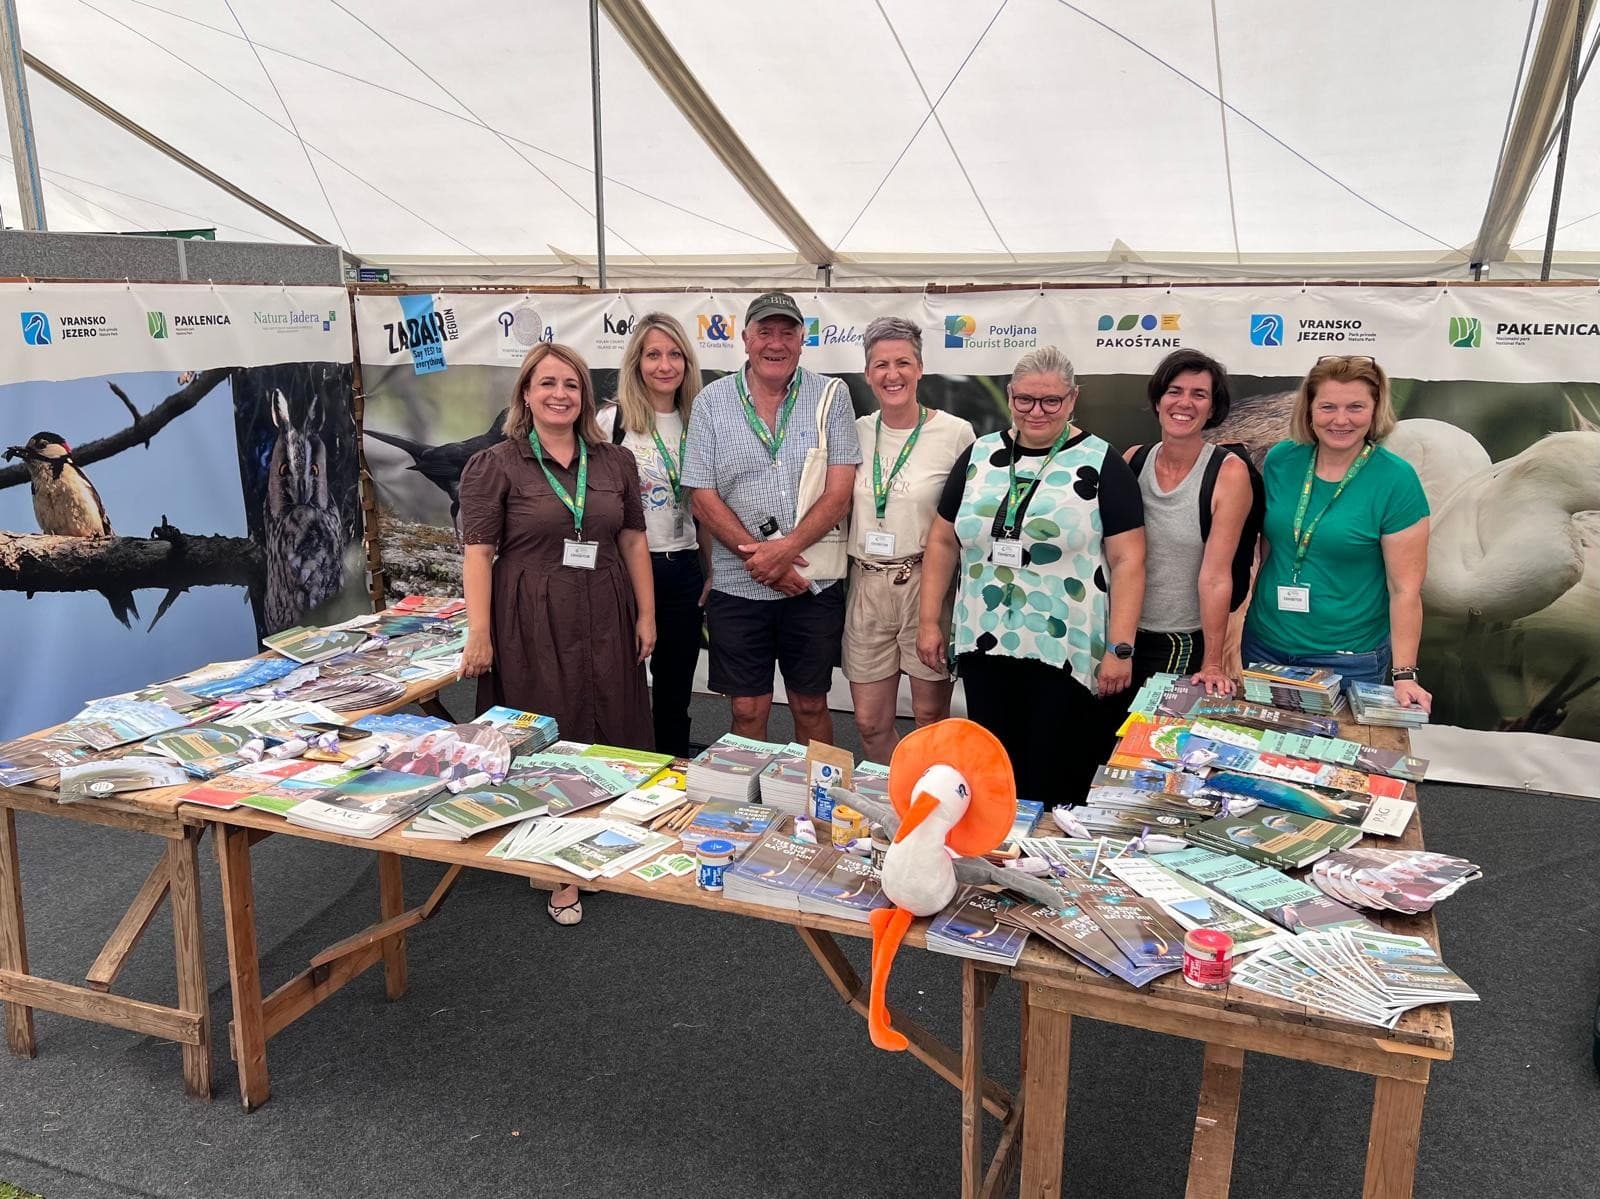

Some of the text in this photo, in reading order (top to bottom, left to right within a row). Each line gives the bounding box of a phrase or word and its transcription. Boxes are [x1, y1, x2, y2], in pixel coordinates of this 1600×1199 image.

[60, 316, 106, 326] VRANSKO
[174, 315, 231, 326] PAKLENICA
[253, 310, 320, 325] Natura Jadera
[443, 308, 459, 341] REGION
[1299, 319, 1362, 329] VRANSKO
[1497, 323, 1600, 336] PAKLENICA
[62, 328, 97, 339] JEZERO
[989, 325, 1037, 337] Povljana
[1297, 331, 1345, 342] JEZERO
[963, 337, 1037, 349] Tourist Board
[412, 349, 423, 360] Say
[415, 358, 445, 369] everything
[324, 807, 364, 820] PAG
[1373, 807, 1390, 823] PAG
[772, 837, 816, 854] THE BIRDS
[843, 859, 861, 867] THE
